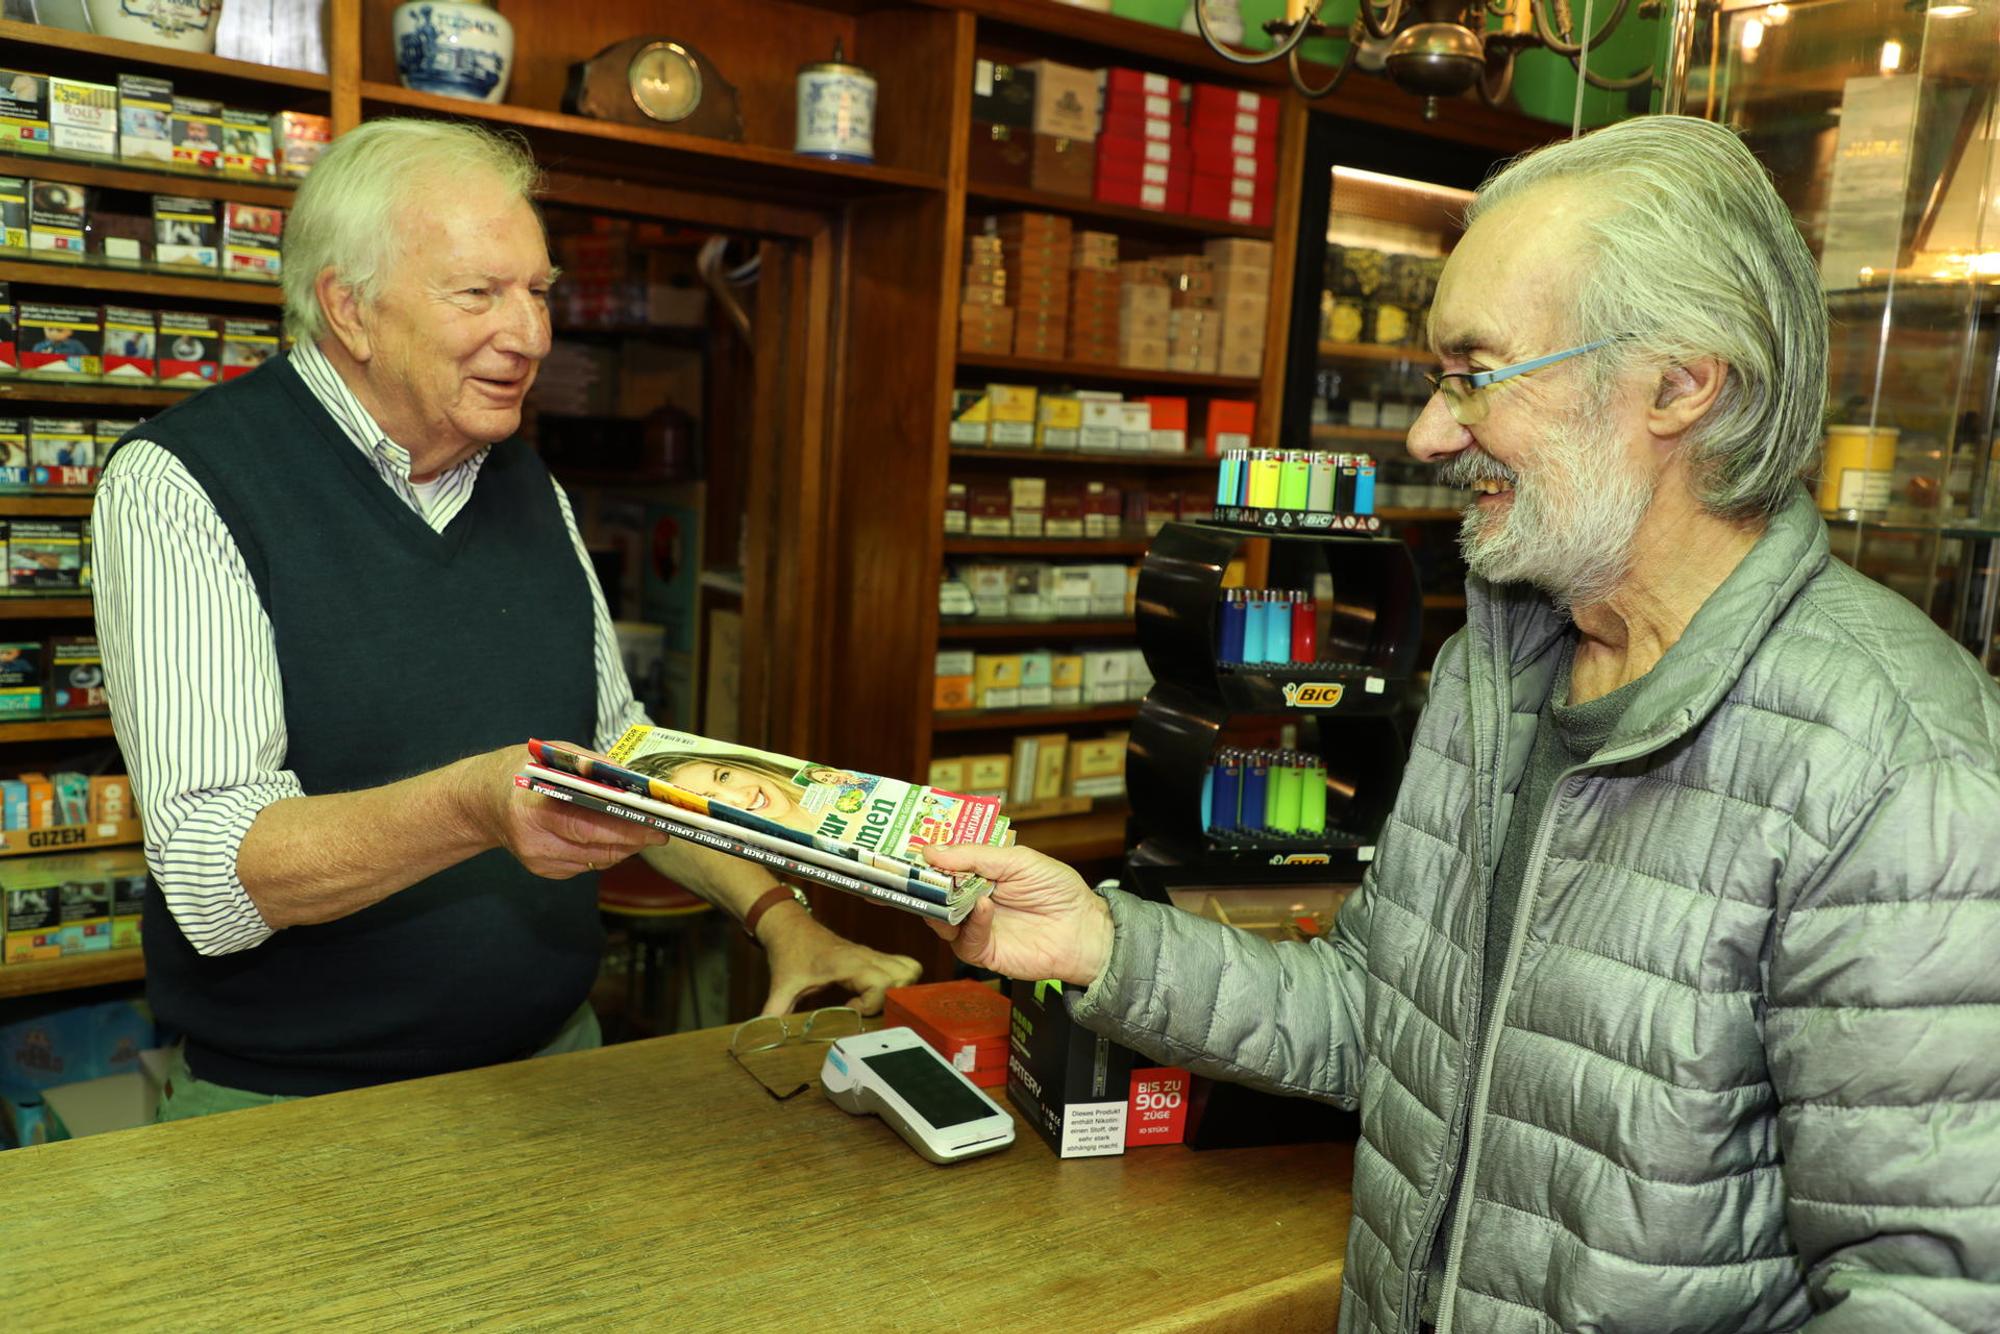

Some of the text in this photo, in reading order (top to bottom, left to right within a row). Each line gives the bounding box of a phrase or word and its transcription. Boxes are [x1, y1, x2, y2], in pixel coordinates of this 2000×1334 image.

[1300, 688, 1338, 702] BIC
[606, 804, 625, 816] FIELD
[626, 810, 646, 823] EAGLE
[667, 823, 694, 838] CAPRICE
[852, 798, 897, 852] men
[29, 828, 86, 848] GIZEH
[696, 832, 732, 849] CHEVROLET
[743, 847, 764, 859] PACER
[765, 854, 786, 866] EDSEL
[798, 864, 826, 879] US-CARS
[827, 875, 860, 889] GÜNSTIGE
[872, 888, 891, 899] F-150
[892, 894, 910, 904] FORD
[1138, 1080, 1182, 1093] BIS ZU
[1135, 1092, 1182, 1111] 900
[1095, 1108, 1121, 1116] Produkt
[1142, 1110, 1170, 1121] ZÜGE
[1067, 1144, 1097, 1152] abhängig
